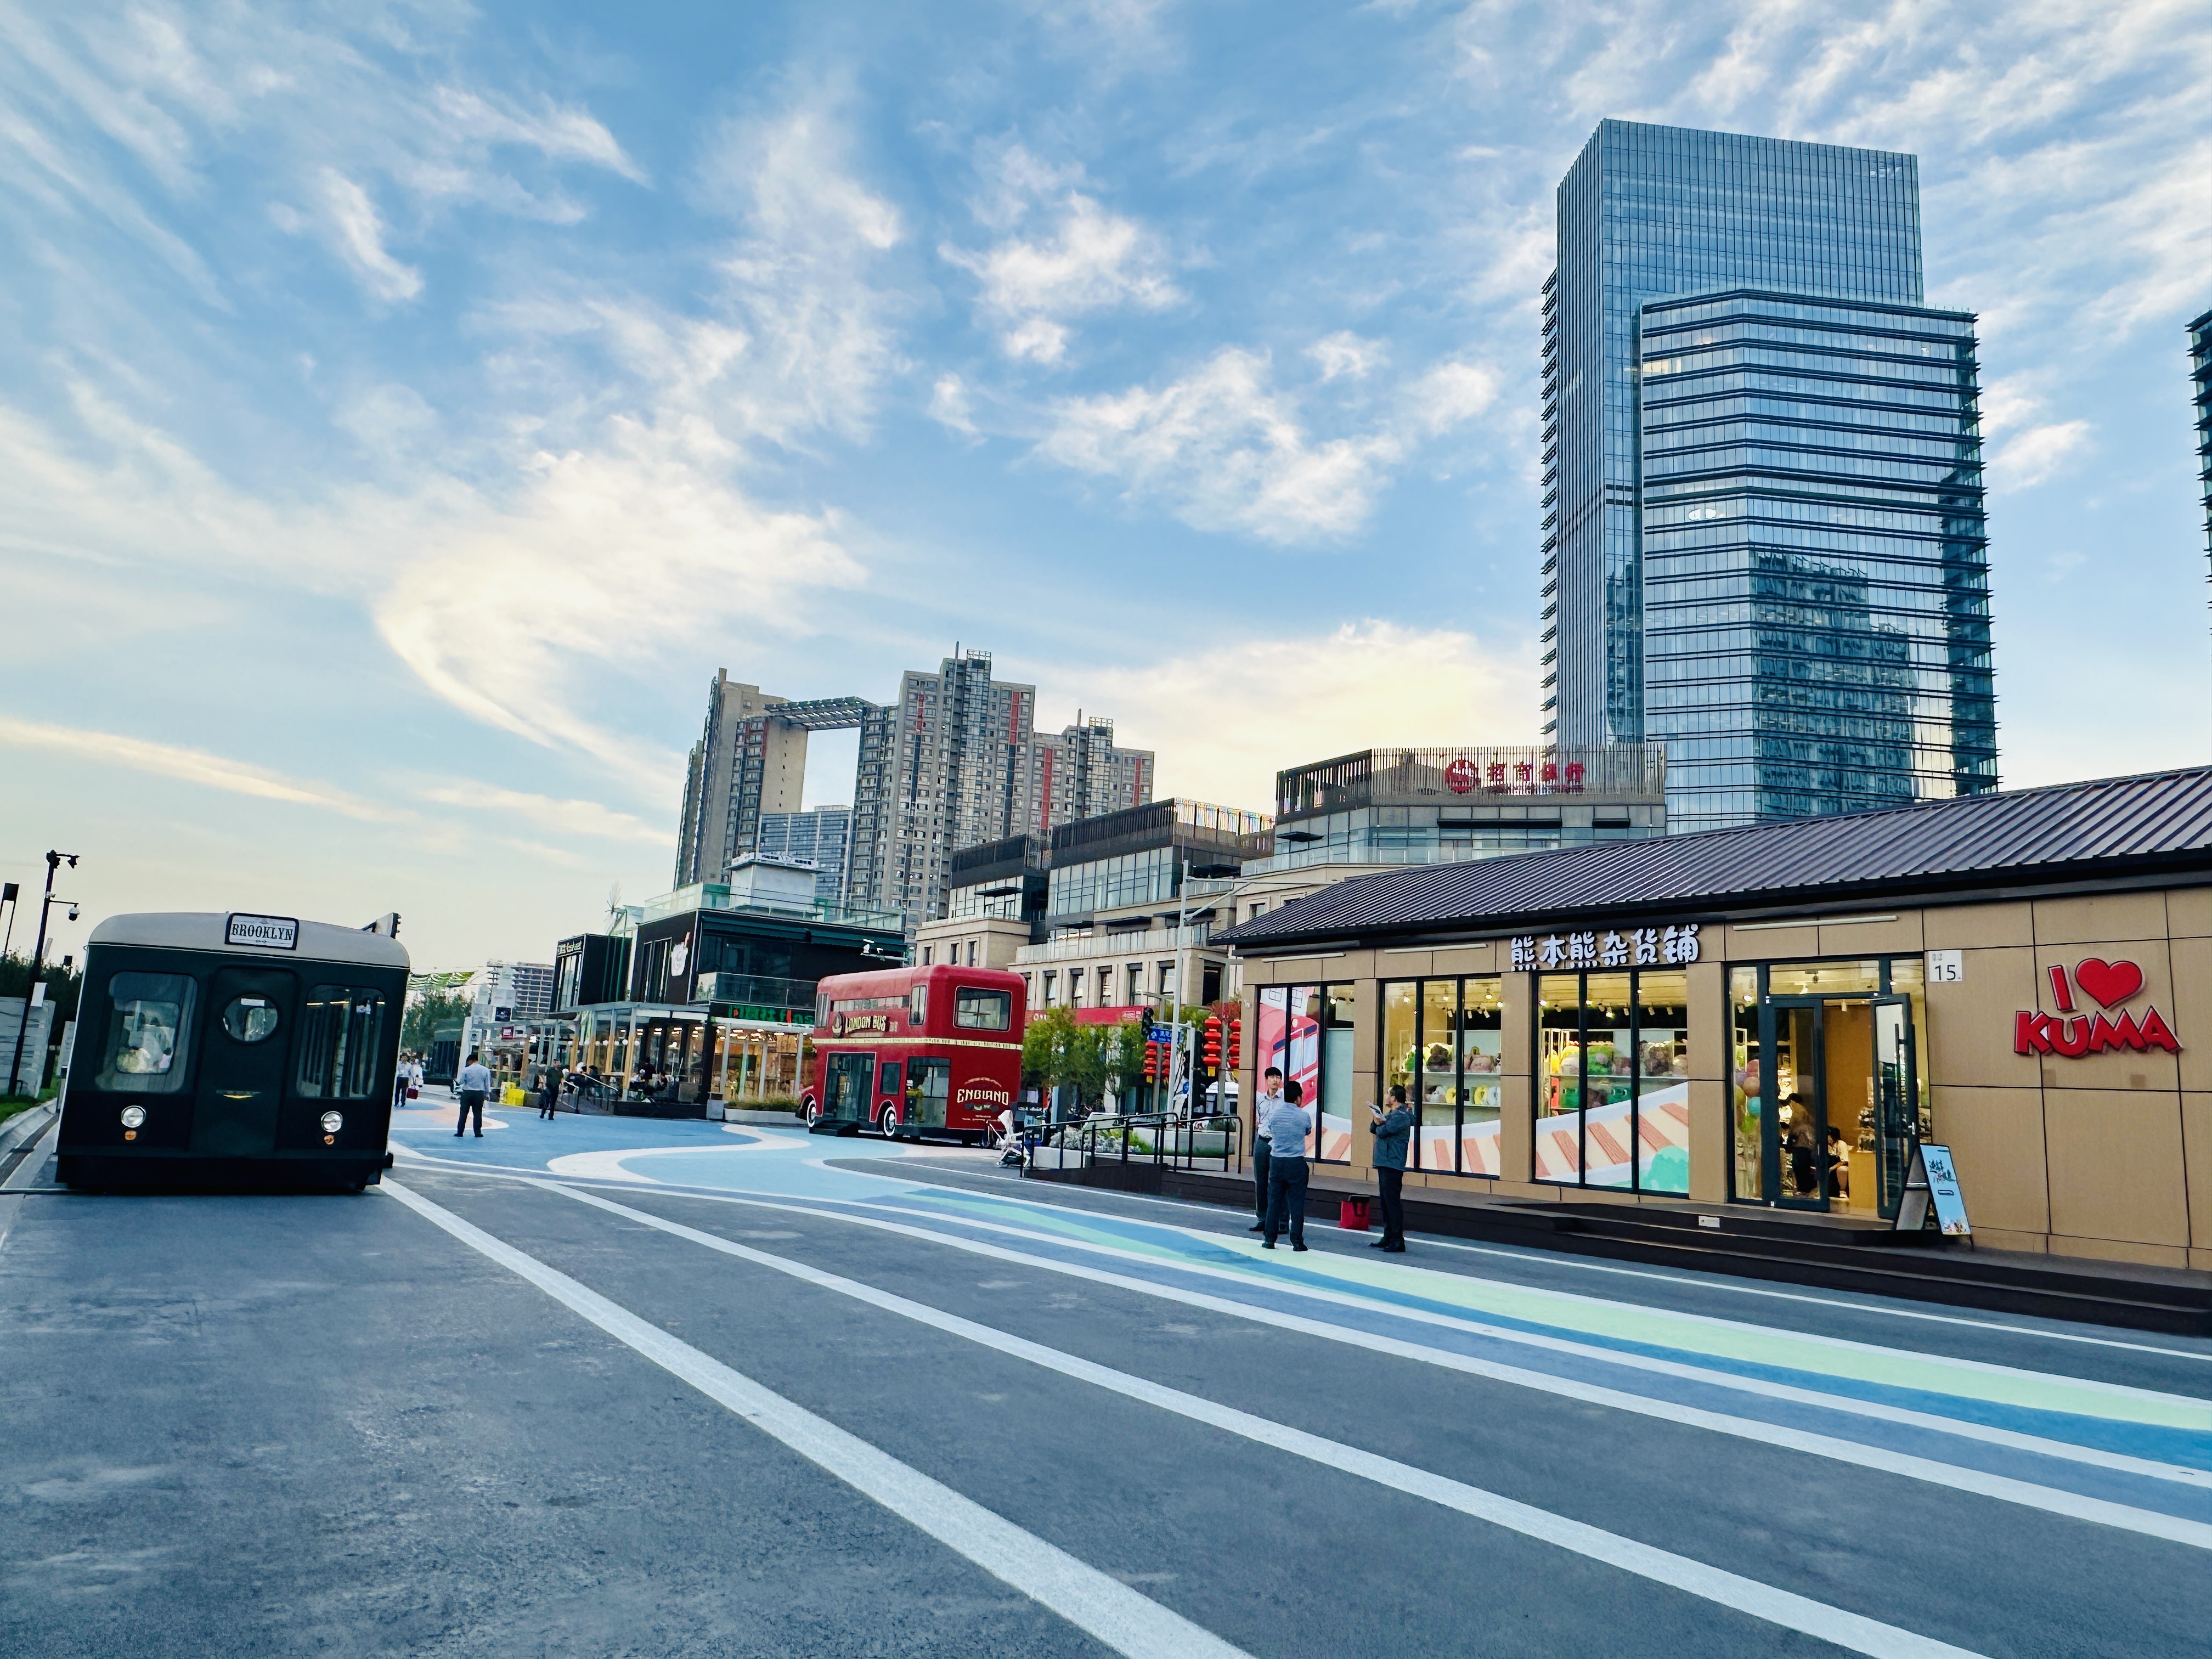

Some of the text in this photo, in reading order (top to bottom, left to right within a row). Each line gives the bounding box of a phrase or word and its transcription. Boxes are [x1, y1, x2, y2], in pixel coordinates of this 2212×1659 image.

[231, 923, 294, 940] BROOKLYN
[1510, 923, 1699, 972] 熊本熊杂货铺
[1934, 964, 1956, 981] 15
[2047, 964, 2077, 1011] I
[845, 1015, 871, 1034] LONDON
[872, 1015, 887, 1032] BUS
[2014, 1005, 2183, 1058] KUMA
[957, 1088, 1009, 1105] ENGLAND
